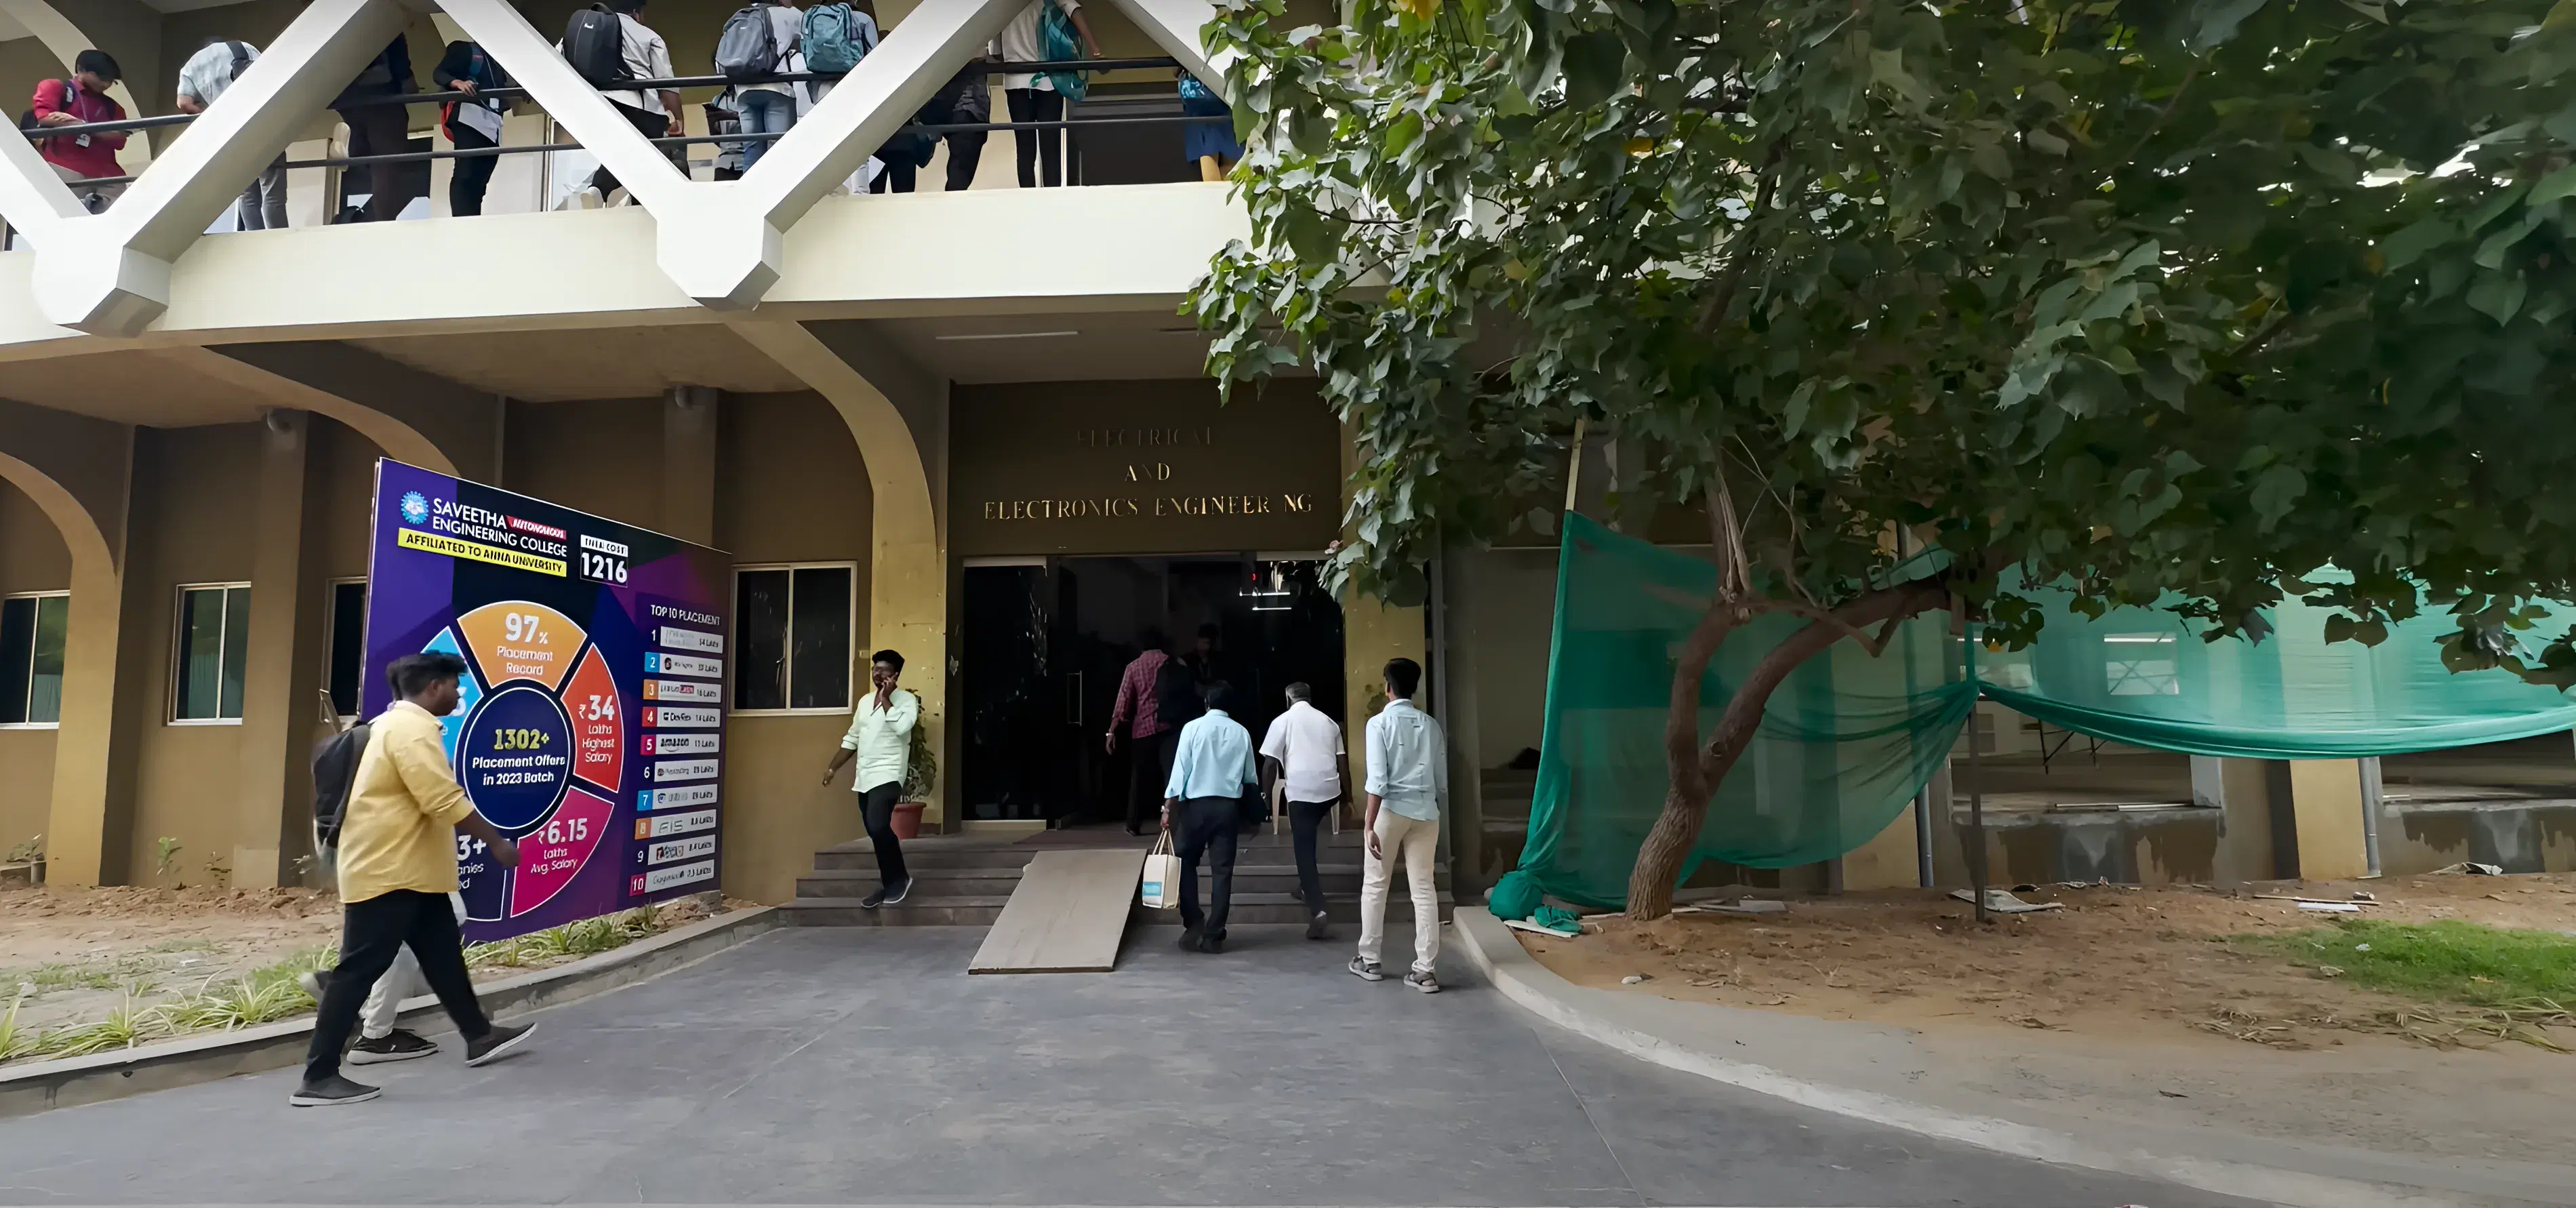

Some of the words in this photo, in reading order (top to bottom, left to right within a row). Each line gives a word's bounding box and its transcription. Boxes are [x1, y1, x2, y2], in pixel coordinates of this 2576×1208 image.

[1125, 462, 1170, 482] AND
[432, 498, 507, 529] SAVEETHA
[985, 498, 1138, 519] ELECTRONICS
[1155, 494, 1311, 516] ENGINEERNG
[432, 516, 517, 546] ENGINEERING
[520, 536, 567, 557] COLLEGE
[406, 533, 465, 554] AFFILIATED
[468, 546, 481, 557] TO
[483, 549, 511, 563] ANNA
[582, 552, 628, 583] 1216
[651, 604, 668, 617] TOP
[669, 607, 677, 619] 10
[505, 612, 548, 645] 97%
[651, 629, 656, 641] 1
[506, 662, 543, 676] Record
[649, 657, 656, 668] 2
[494, 728, 550, 750] 1302+
[646, 738, 653, 751] 5
[472, 756, 534, 769] Placement
[535, 754, 565, 766] Offers
[483, 773, 494, 786] in
[496, 772, 522, 785] 2023
[524, 771, 555, 783] Batch
[644, 766, 650, 779] 6
[643, 794, 649, 806] 7
[637, 850, 644, 862] 9
[633, 878, 644, 891] 10
